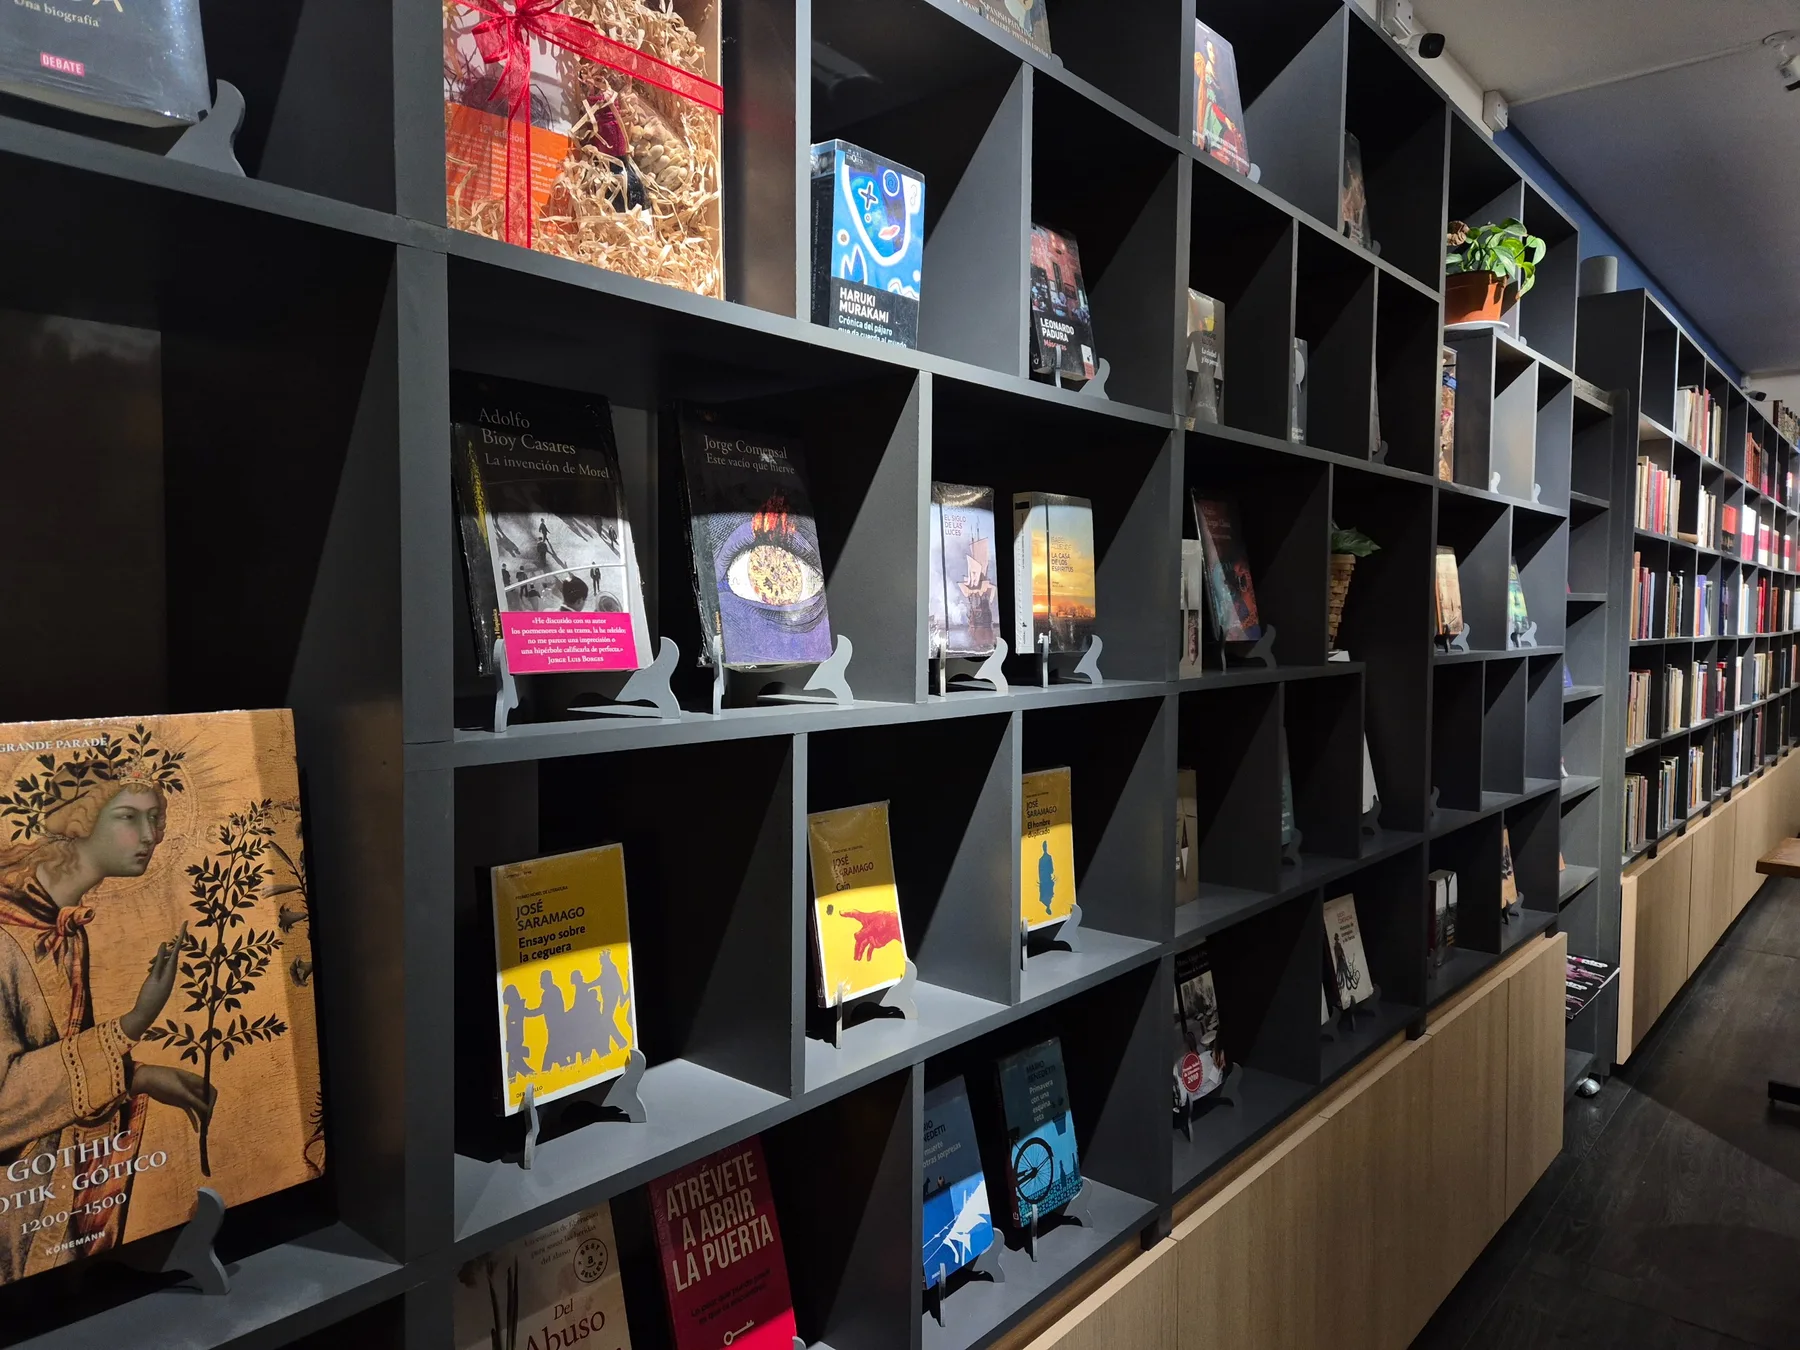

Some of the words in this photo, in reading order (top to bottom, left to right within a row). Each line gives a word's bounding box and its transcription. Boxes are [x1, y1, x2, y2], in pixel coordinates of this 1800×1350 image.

[44, 3, 100, 27] biografía
[42, 54, 83, 74] DEBATE
[494, 130, 525, 144] ediión
[840, 287, 876, 307] HARUKI
[839, 300, 889, 323] MURAKAMI
[838, 315, 863, 328] Crónica
[864, 321, 874, 331] del
[874, 325, 893, 336] pájaro
[1040, 317, 1075, 335] LEONARDO
[1041, 328, 1069, 342] PADURA
[479, 408, 530, 429] Adolfo
[482, 427, 516, 451] Bioy
[521, 434, 576, 455] Casares
[703, 434, 733, 455] Jorge
[735, 440, 788, 460] Comensal
[485, 453, 500, 466] La
[504, 456, 559, 473] invención
[562, 462, 576, 474] de
[579, 463, 610, 479] Morel
[706, 452, 726, 465] Este
[728, 457, 751, 468] vacío
[752, 461, 768, 473] que
[770, 461, 796, 475] hierve
[511, 627, 520, 635] los
[548, 637, 567, 645] parece
[591, 645, 598, 653] de
[56, 737, 108, 748] PARADE
[1026, 805, 1057, 818] SARAMAGO
[832, 853, 850, 870] JOSÉ
[515, 899, 544, 921] JOSÉ
[517, 907, 585, 932] SARAMAGO
[518, 933, 556, 949] Ensayo
[558, 925, 586, 940] sobre
[519, 951, 529, 963] la
[531, 943, 572, 960] ceguera
[1028, 1080, 1054, 1095] Primavera
[6, 1130, 132, 1183] GOTHIC
[923, 1156, 937, 1168] otras
[937, 1142, 962, 1160] sorpresas
[924, 1141, 944, 1156] muerte
[72, 1151, 168, 1191] GÓTICO
[666, 1151, 758, 1221] ATRÉVETE
[682, 1217, 697, 1250] A
[701, 1187, 756, 1242] ABRIR
[580, 1243, 600, 1255] BEST
[672, 1251, 701, 1293] LA
[702, 1214, 774, 1276] PUERTA
[580, 1260, 603, 1278] SELLER
[554, 1298, 574, 1320] Del
[526, 1311, 605, 1350] Abuso
